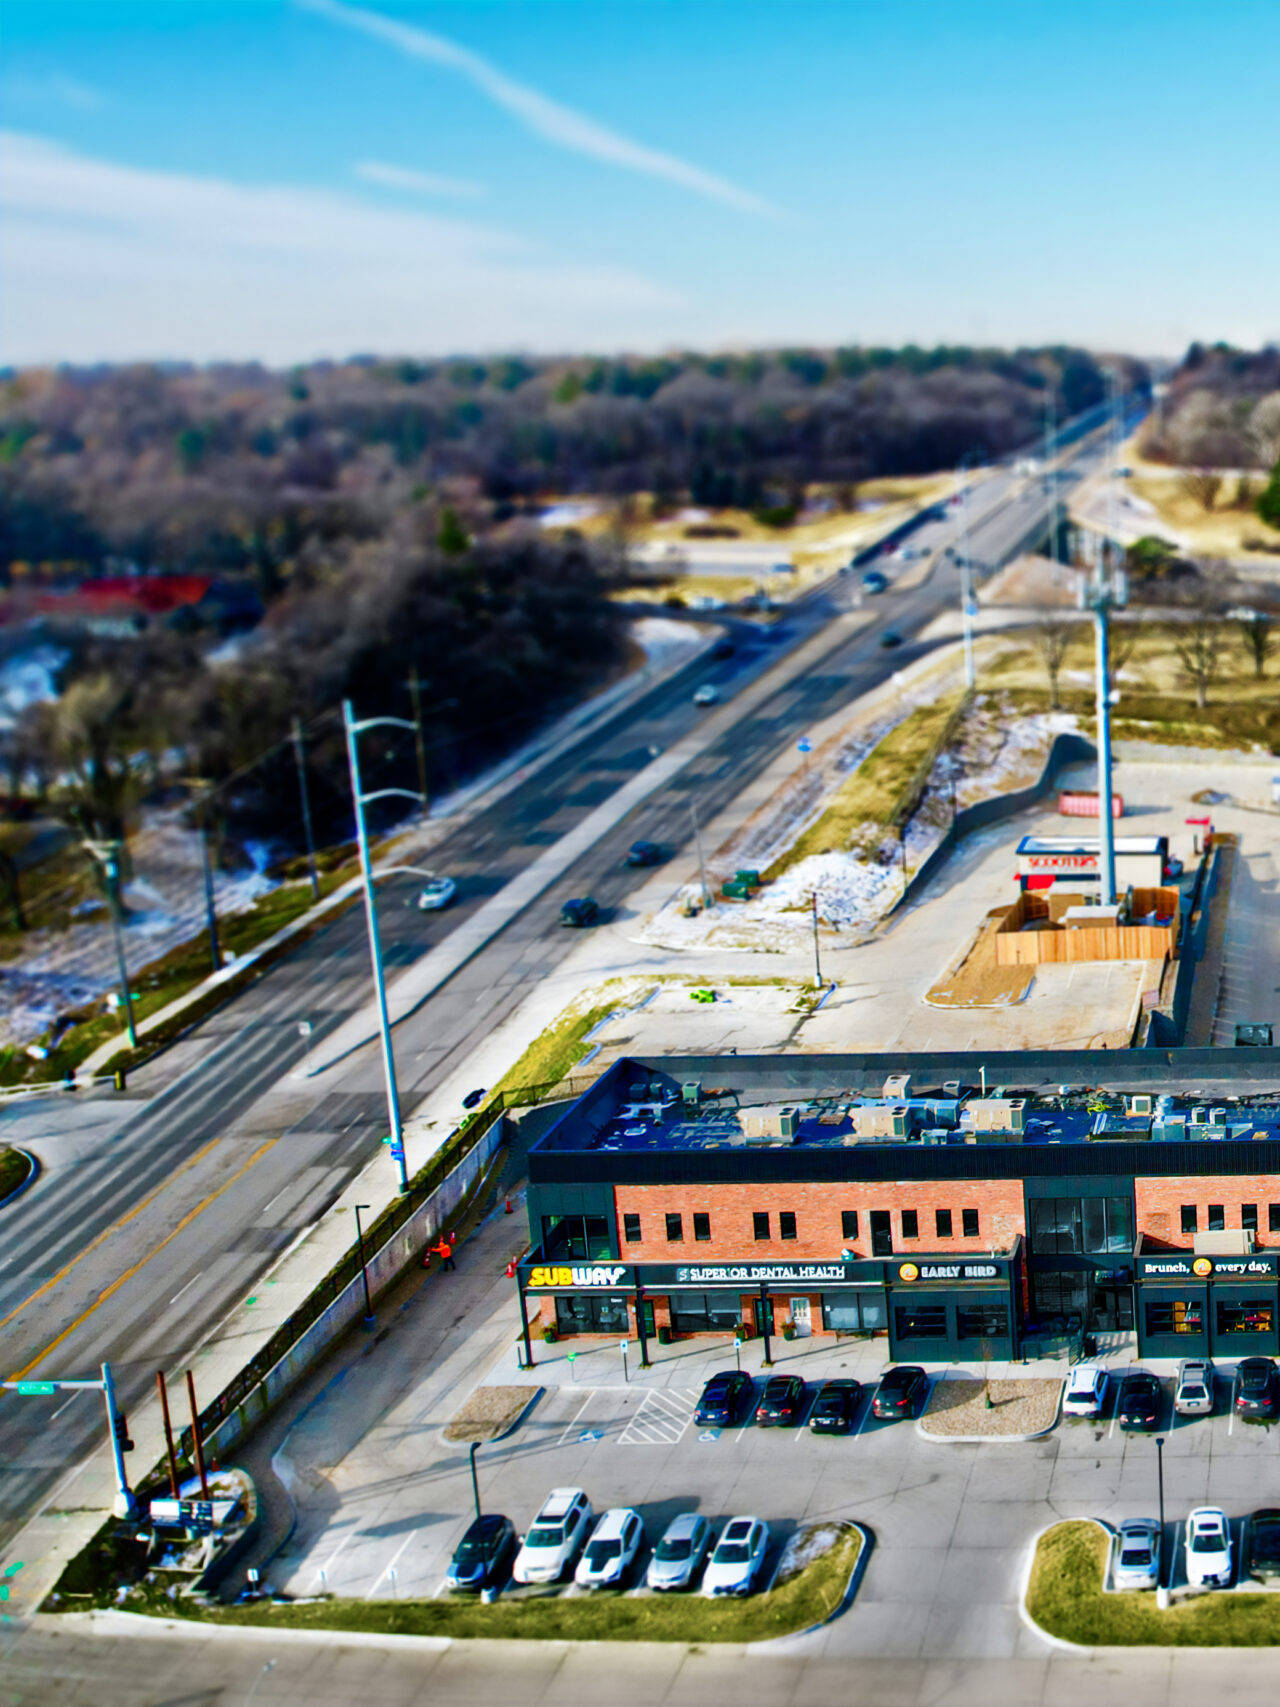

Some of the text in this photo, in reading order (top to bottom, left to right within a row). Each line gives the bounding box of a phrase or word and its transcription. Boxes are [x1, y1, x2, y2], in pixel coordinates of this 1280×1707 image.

[751, 1266, 798, 1280] DENTAL
[799, 1265, 846, 1279] HEALTH
[921, 1265, 997, 1278] EARLY BIRD
[1145, 1261, 1272, 1273] Brunch, every day.
[528, 1266, 626, 1287] SUBWAY
